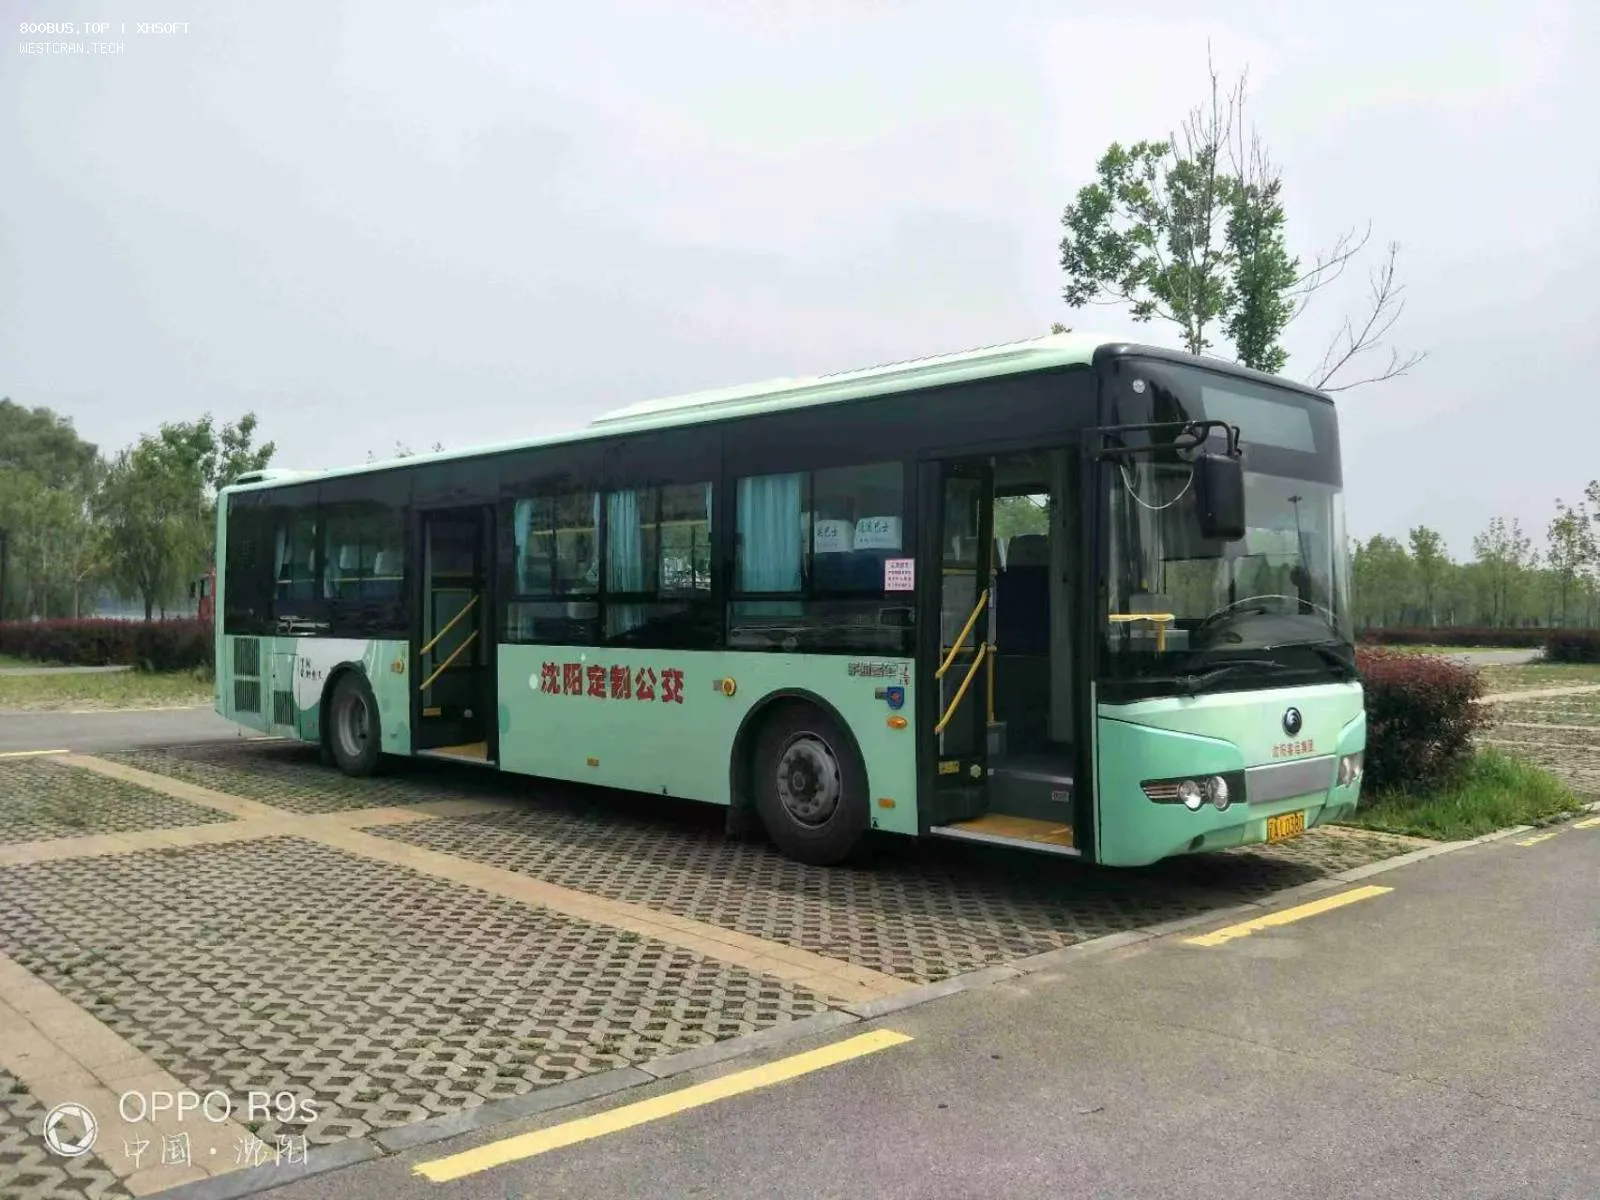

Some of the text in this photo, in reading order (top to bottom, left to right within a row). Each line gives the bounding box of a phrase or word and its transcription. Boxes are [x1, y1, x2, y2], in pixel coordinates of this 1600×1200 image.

[540, 661, 684, 704] 沈阳定制公交
